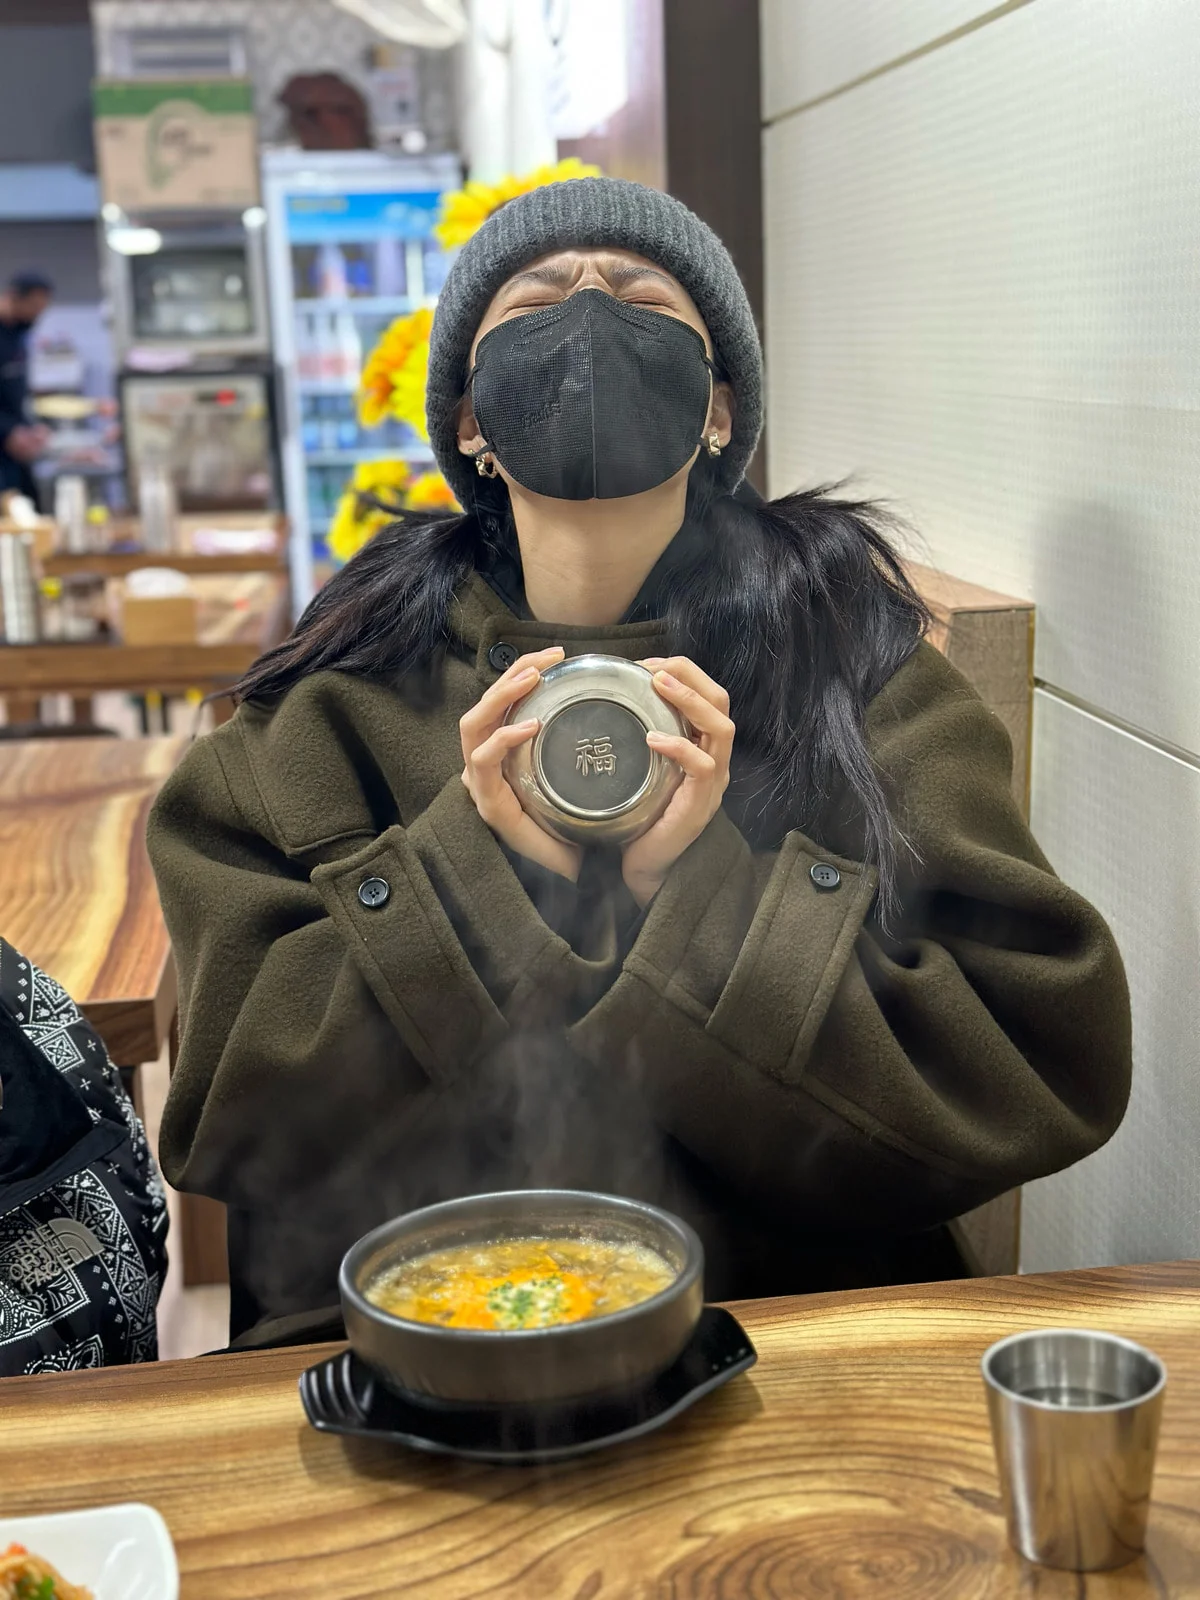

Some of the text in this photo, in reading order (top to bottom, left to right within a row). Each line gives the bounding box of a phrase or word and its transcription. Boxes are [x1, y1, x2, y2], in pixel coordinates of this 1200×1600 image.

[575, 736, 617, 777] 福
[9, 1237, 66, 1281] ORTH
[14, 1224, 55, 1254] THE
[23, 1253, 76, 1294] FACE
